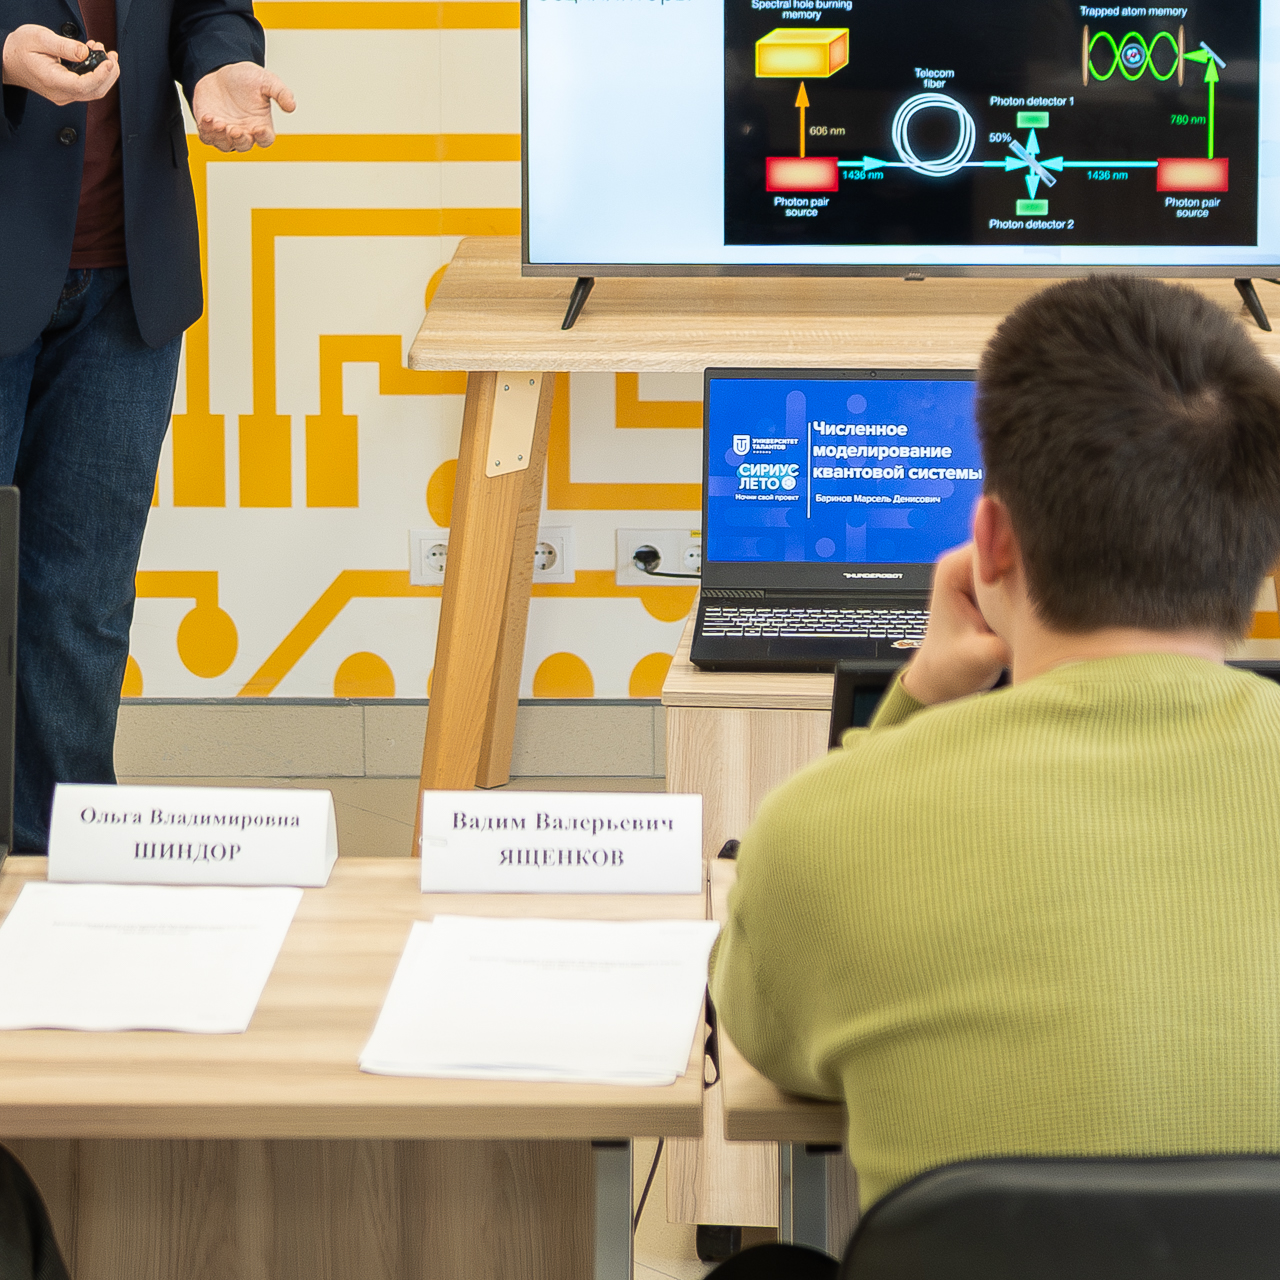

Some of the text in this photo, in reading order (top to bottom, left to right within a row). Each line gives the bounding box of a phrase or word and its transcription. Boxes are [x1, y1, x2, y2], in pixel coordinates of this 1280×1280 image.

[751, 0, 853, 11] Spectral hole burning
[782, 10, 822, 21] memory
[1080, 5, 1188, 18] Trapped atom memory
[914, 67, 955, 78] Telecom
[923, 78, 946, 88] fiber
[990, 95, 1025, 106] Photon
[1026, 96, 1067, 106] detector
[1190, 116, 1206, 125] nm
[809, 126, 846, 136] 606 nm
[989, 132, 1012, 142] 50%
[842, 170, 884, 180] 1436 nm
[1087, 170, 1128, 180] 1436 nm
[773, 197, 829, 208] Photon pair
[1164, 197, 1221, 209] Photon pair
[785, 208, 818, 217] source
[1176, 208, 1209, 218] source
[989, 219, 1075, 230] Photon detector 2
[812, 421, 908, 436] Численное
[812, 445, 953, 460] моделирование
[738, 463, 800, 477] СИРИУС
[812, 464, 983, 480] квантовой системы
[738, 477, 780, 490] ЛЕТО
[774, 494, 800, 502] проект
[815, 493, 941, 504] Баринов Марсель Денисович
[80, 806, 300, 831] Ольга Владимировна
[451, 810, 674, 836] Вадим Валерьевич
[133, 841, 242, 864] ШИНДОР
[498, 848, 624, 869] ЯЩЕНКОВ
